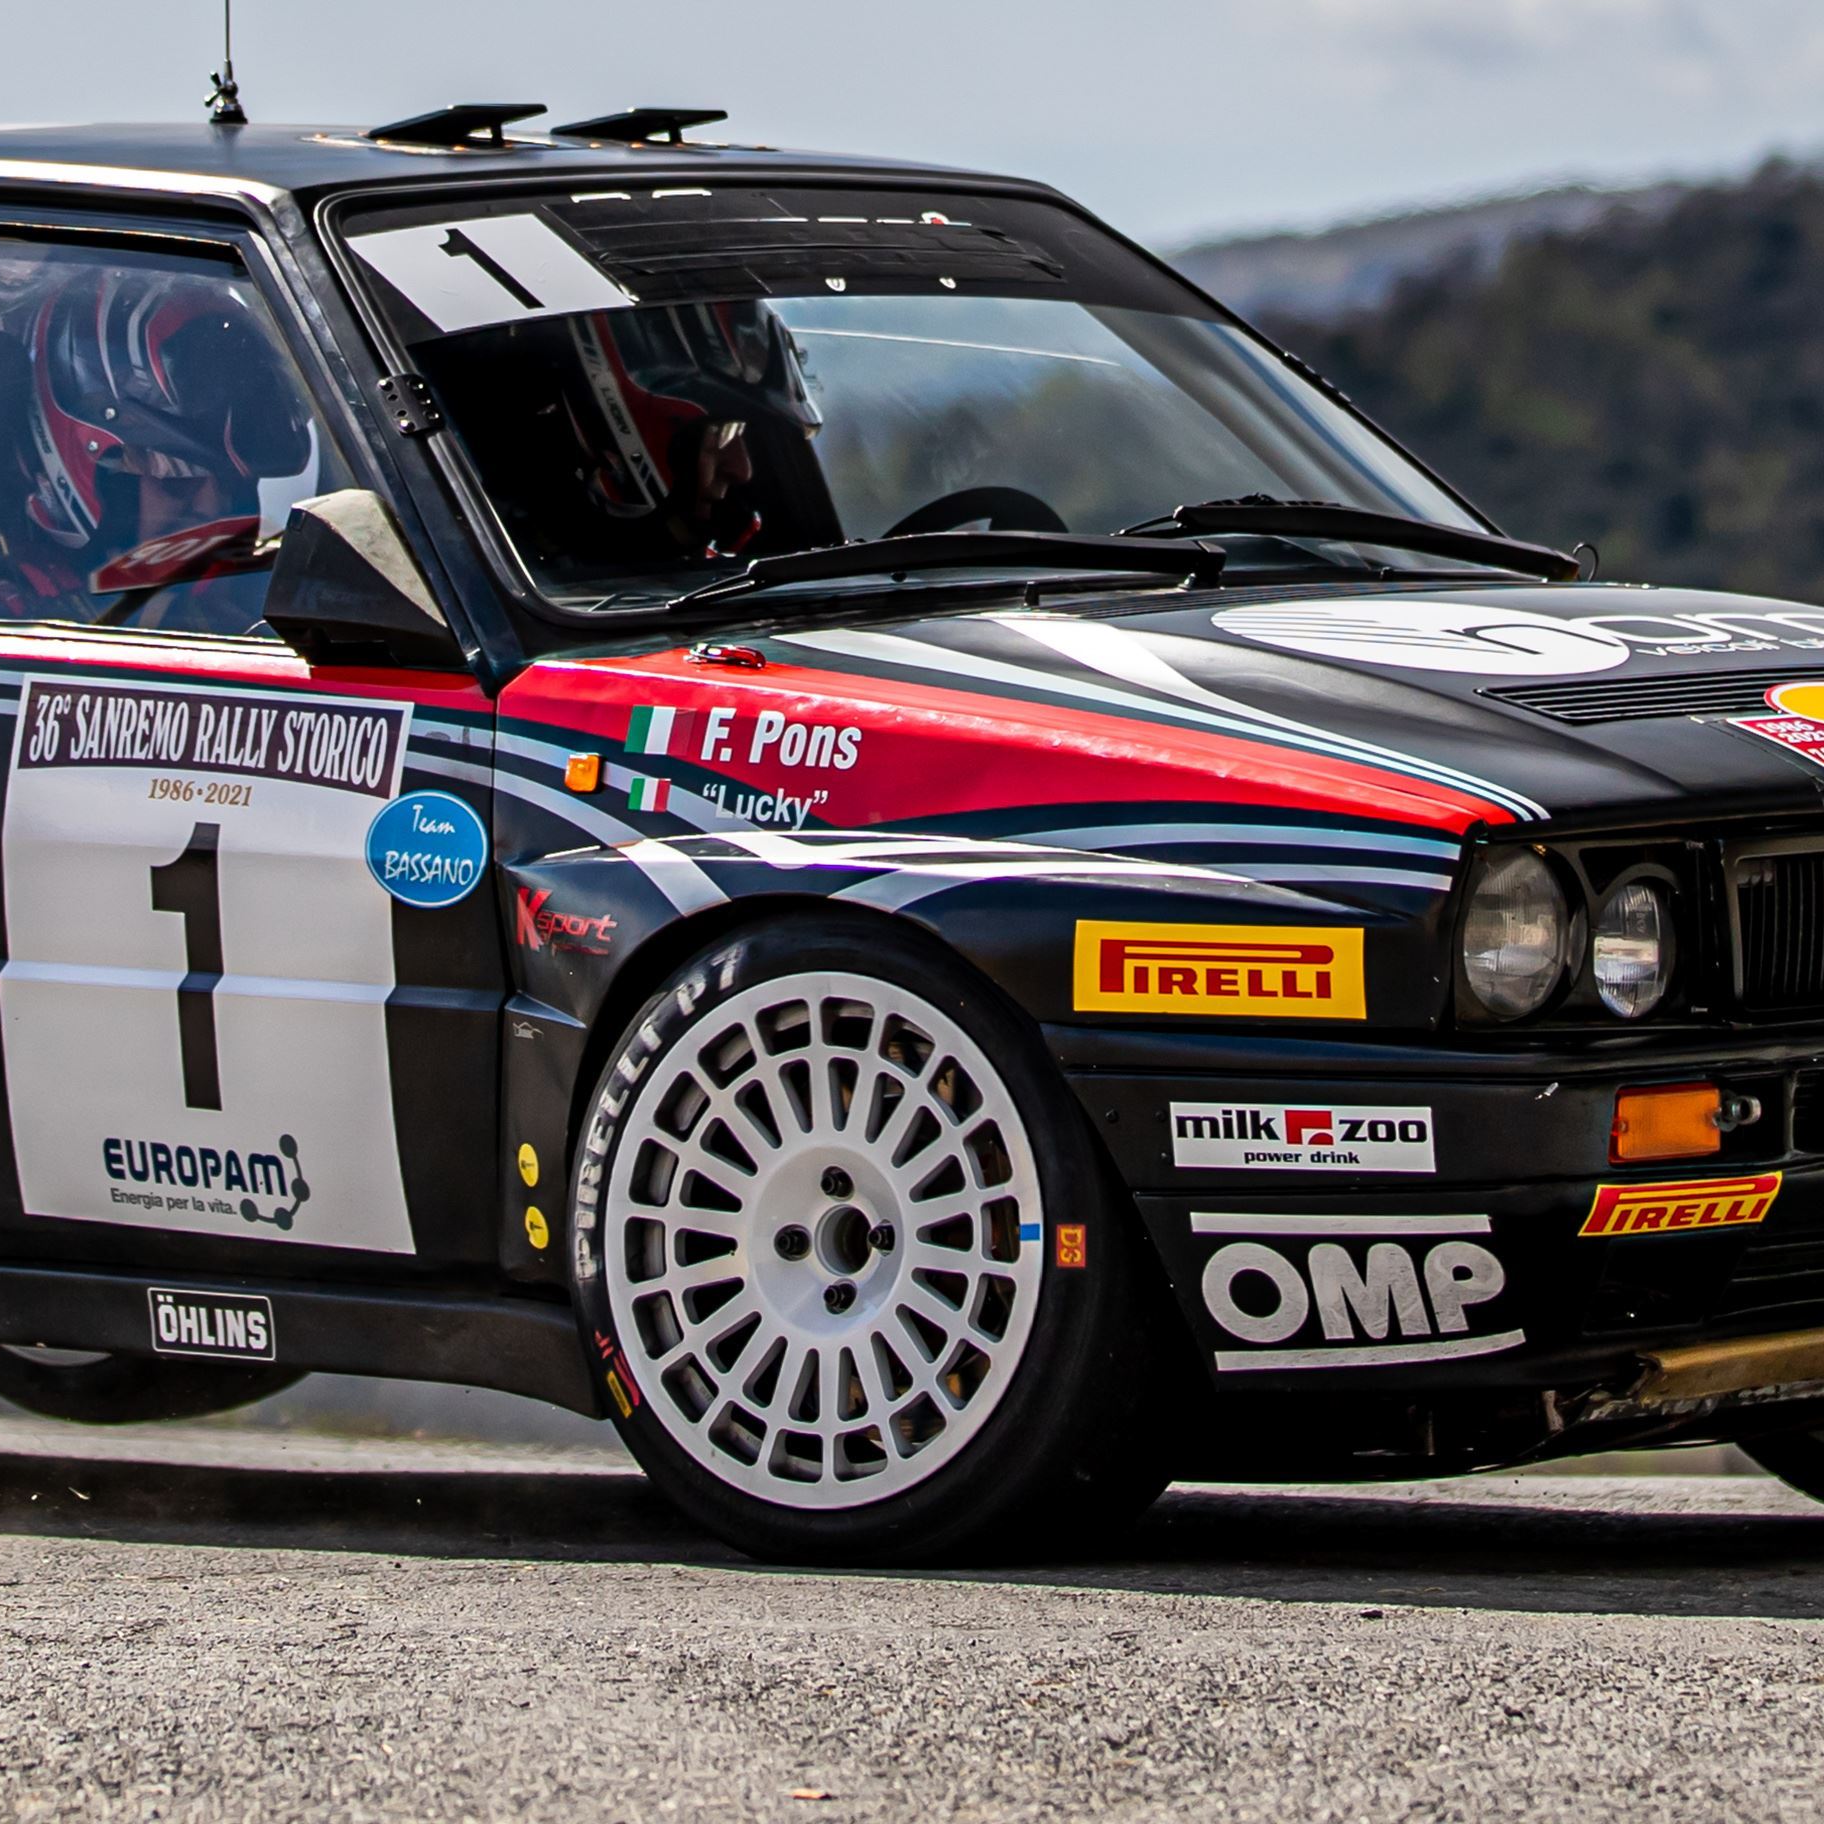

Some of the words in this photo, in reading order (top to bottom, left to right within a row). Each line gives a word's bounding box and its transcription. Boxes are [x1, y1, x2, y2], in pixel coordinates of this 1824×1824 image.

[437, 227, 546, 310] 1
[70, 693, 189, 764] SANREMO
[192, 703, 278, 770] RALLY
[277, 709, 388, 790] STORICO
[700, 707, 737, 763] F.
[747, 709, 863, 771] Pons
[411, 803, 457, 835] Team
[384, 850, 474, 886] BASSANO
[150, 821, 224, 1112] 1
[1099, 938, 1335, 1000] PIRELLI
[1176, 1109, 1281, 1142] milk
[1338, 1117, 1429, 1144] zoo
[1243, 1149, 1303, 1166] power
[1310, 1150, 1361, 1165] drink
[110, 1187, 164, 1210] Energia
[166, 1197, 190, 1211] per
[191, 1196, 206, 1213] la
[207, 1198, 238, 1216] vita.
[1584, 1175, 1779, 1233] PIRELLI
[1201, 1240, 1507, 1344] OMP
[156, 1293, 269, 1351] ÖHLINS
